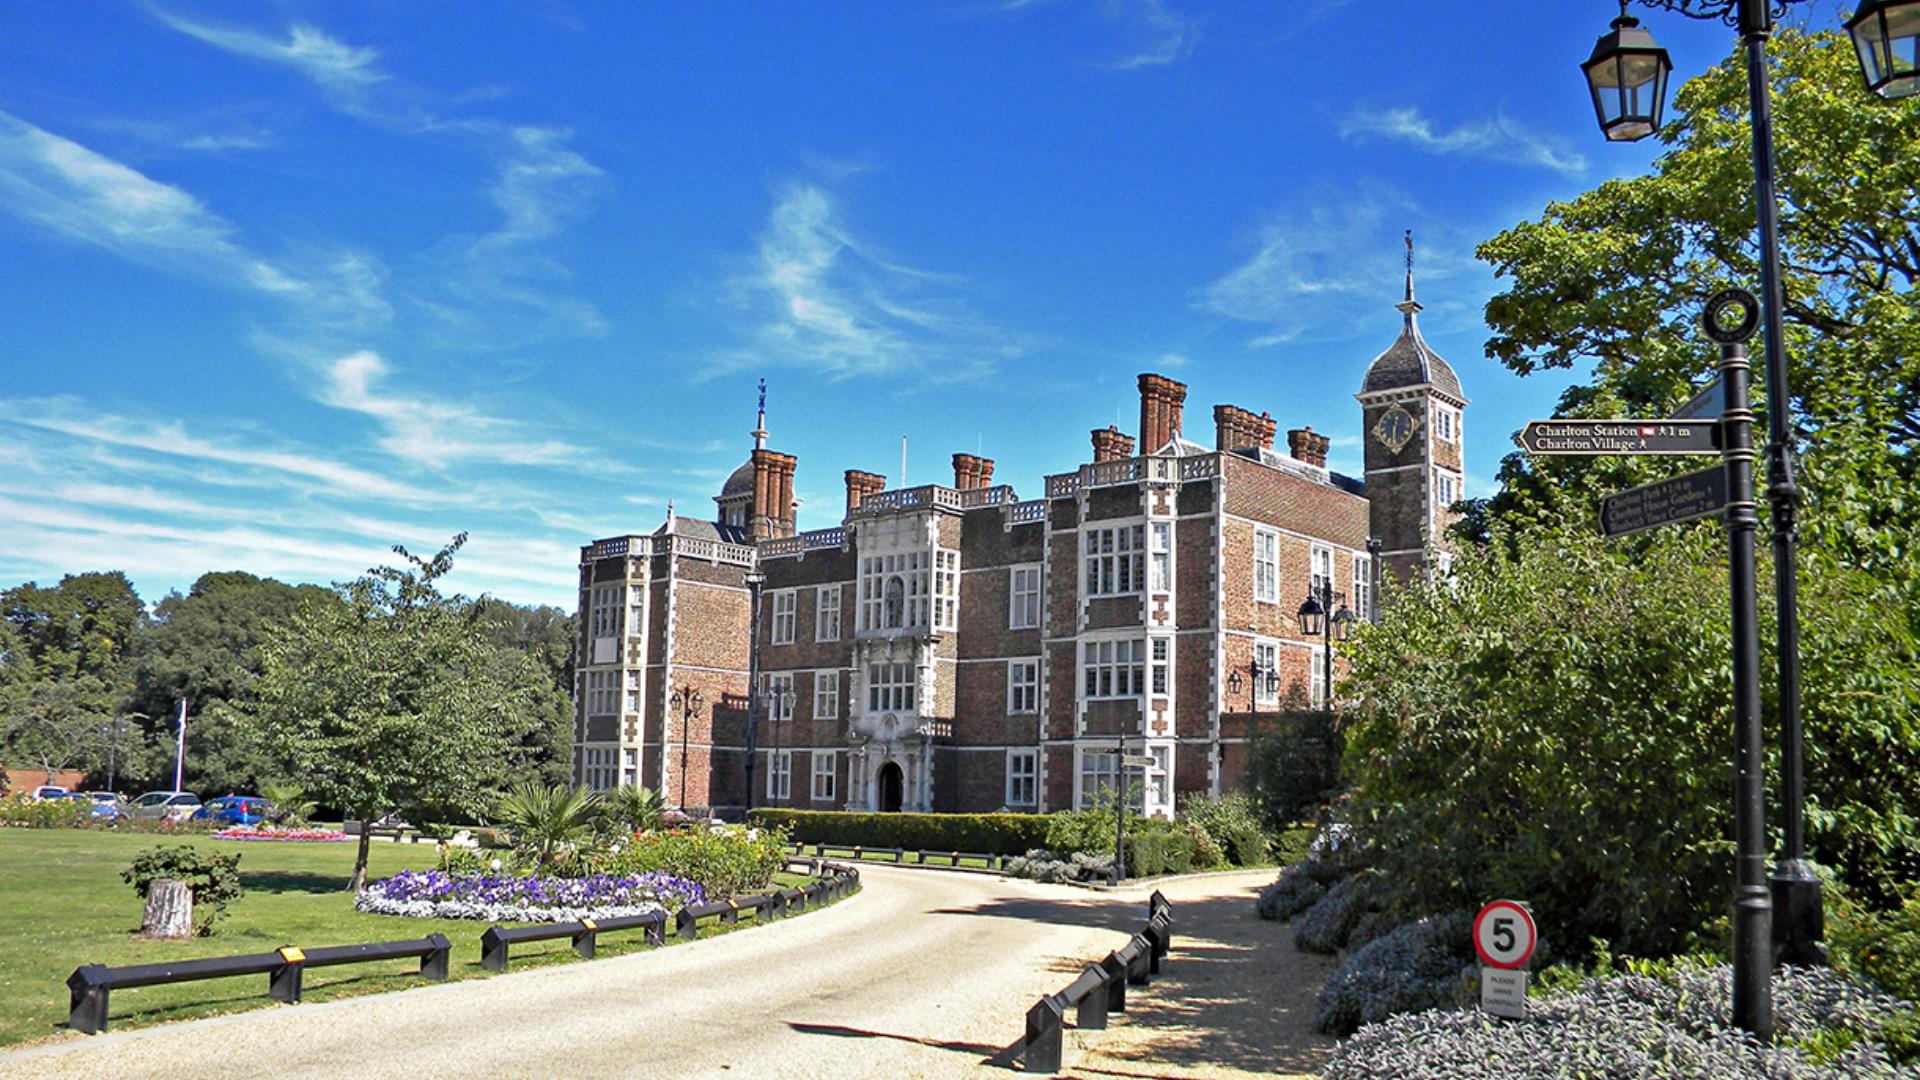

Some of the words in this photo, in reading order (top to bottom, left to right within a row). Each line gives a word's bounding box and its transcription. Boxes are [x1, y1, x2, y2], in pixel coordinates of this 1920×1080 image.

[1535, 424, 1590, 436] Charlton
[1593, 424, 1638, 436] Station
[1669, 426, 1674, 436] 1
[1678, 427, 1690, 436] m
[1535, 438, 1590, 449] Charlton
[1591, 438, 1636, 452] Village
[1670, 489, 1705, 505] Gardens
[1668, 505, 1697, 518] Centre
[1493, 918, 1516, 952] 5
[1491, 977, 1515, 985] PLEASE
